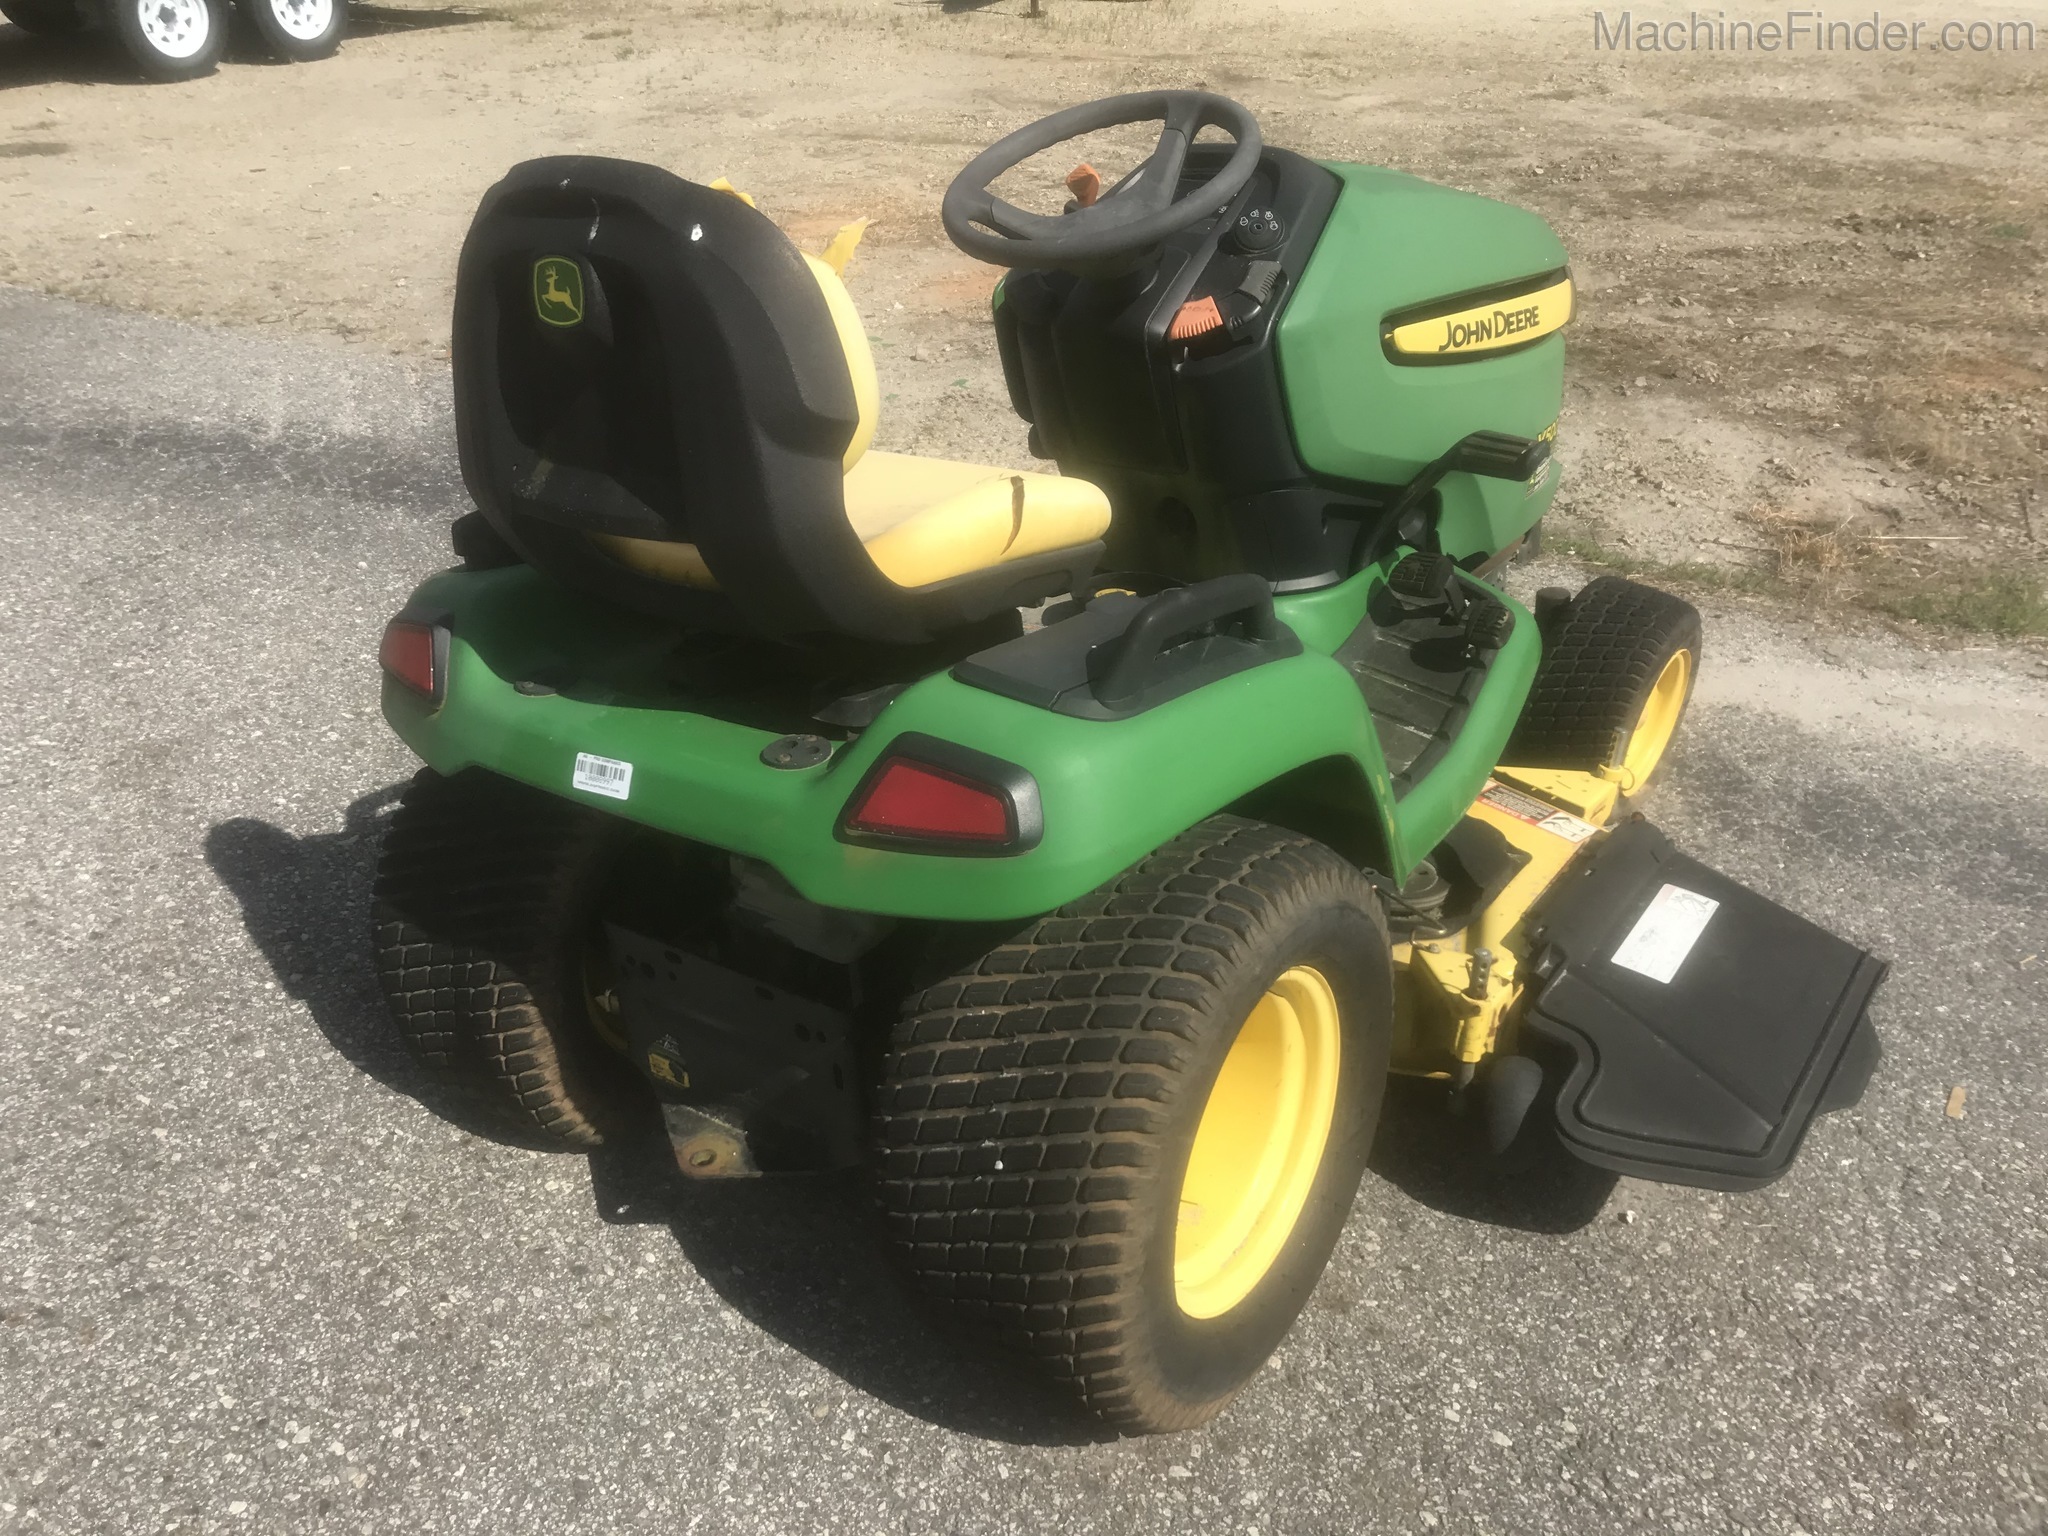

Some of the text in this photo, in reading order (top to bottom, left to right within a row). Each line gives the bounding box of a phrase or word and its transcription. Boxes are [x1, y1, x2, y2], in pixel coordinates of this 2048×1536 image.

[1438, 305, 1541, 352] JOHN DEERE
[1481, 797, 1521, 818] DANGER
